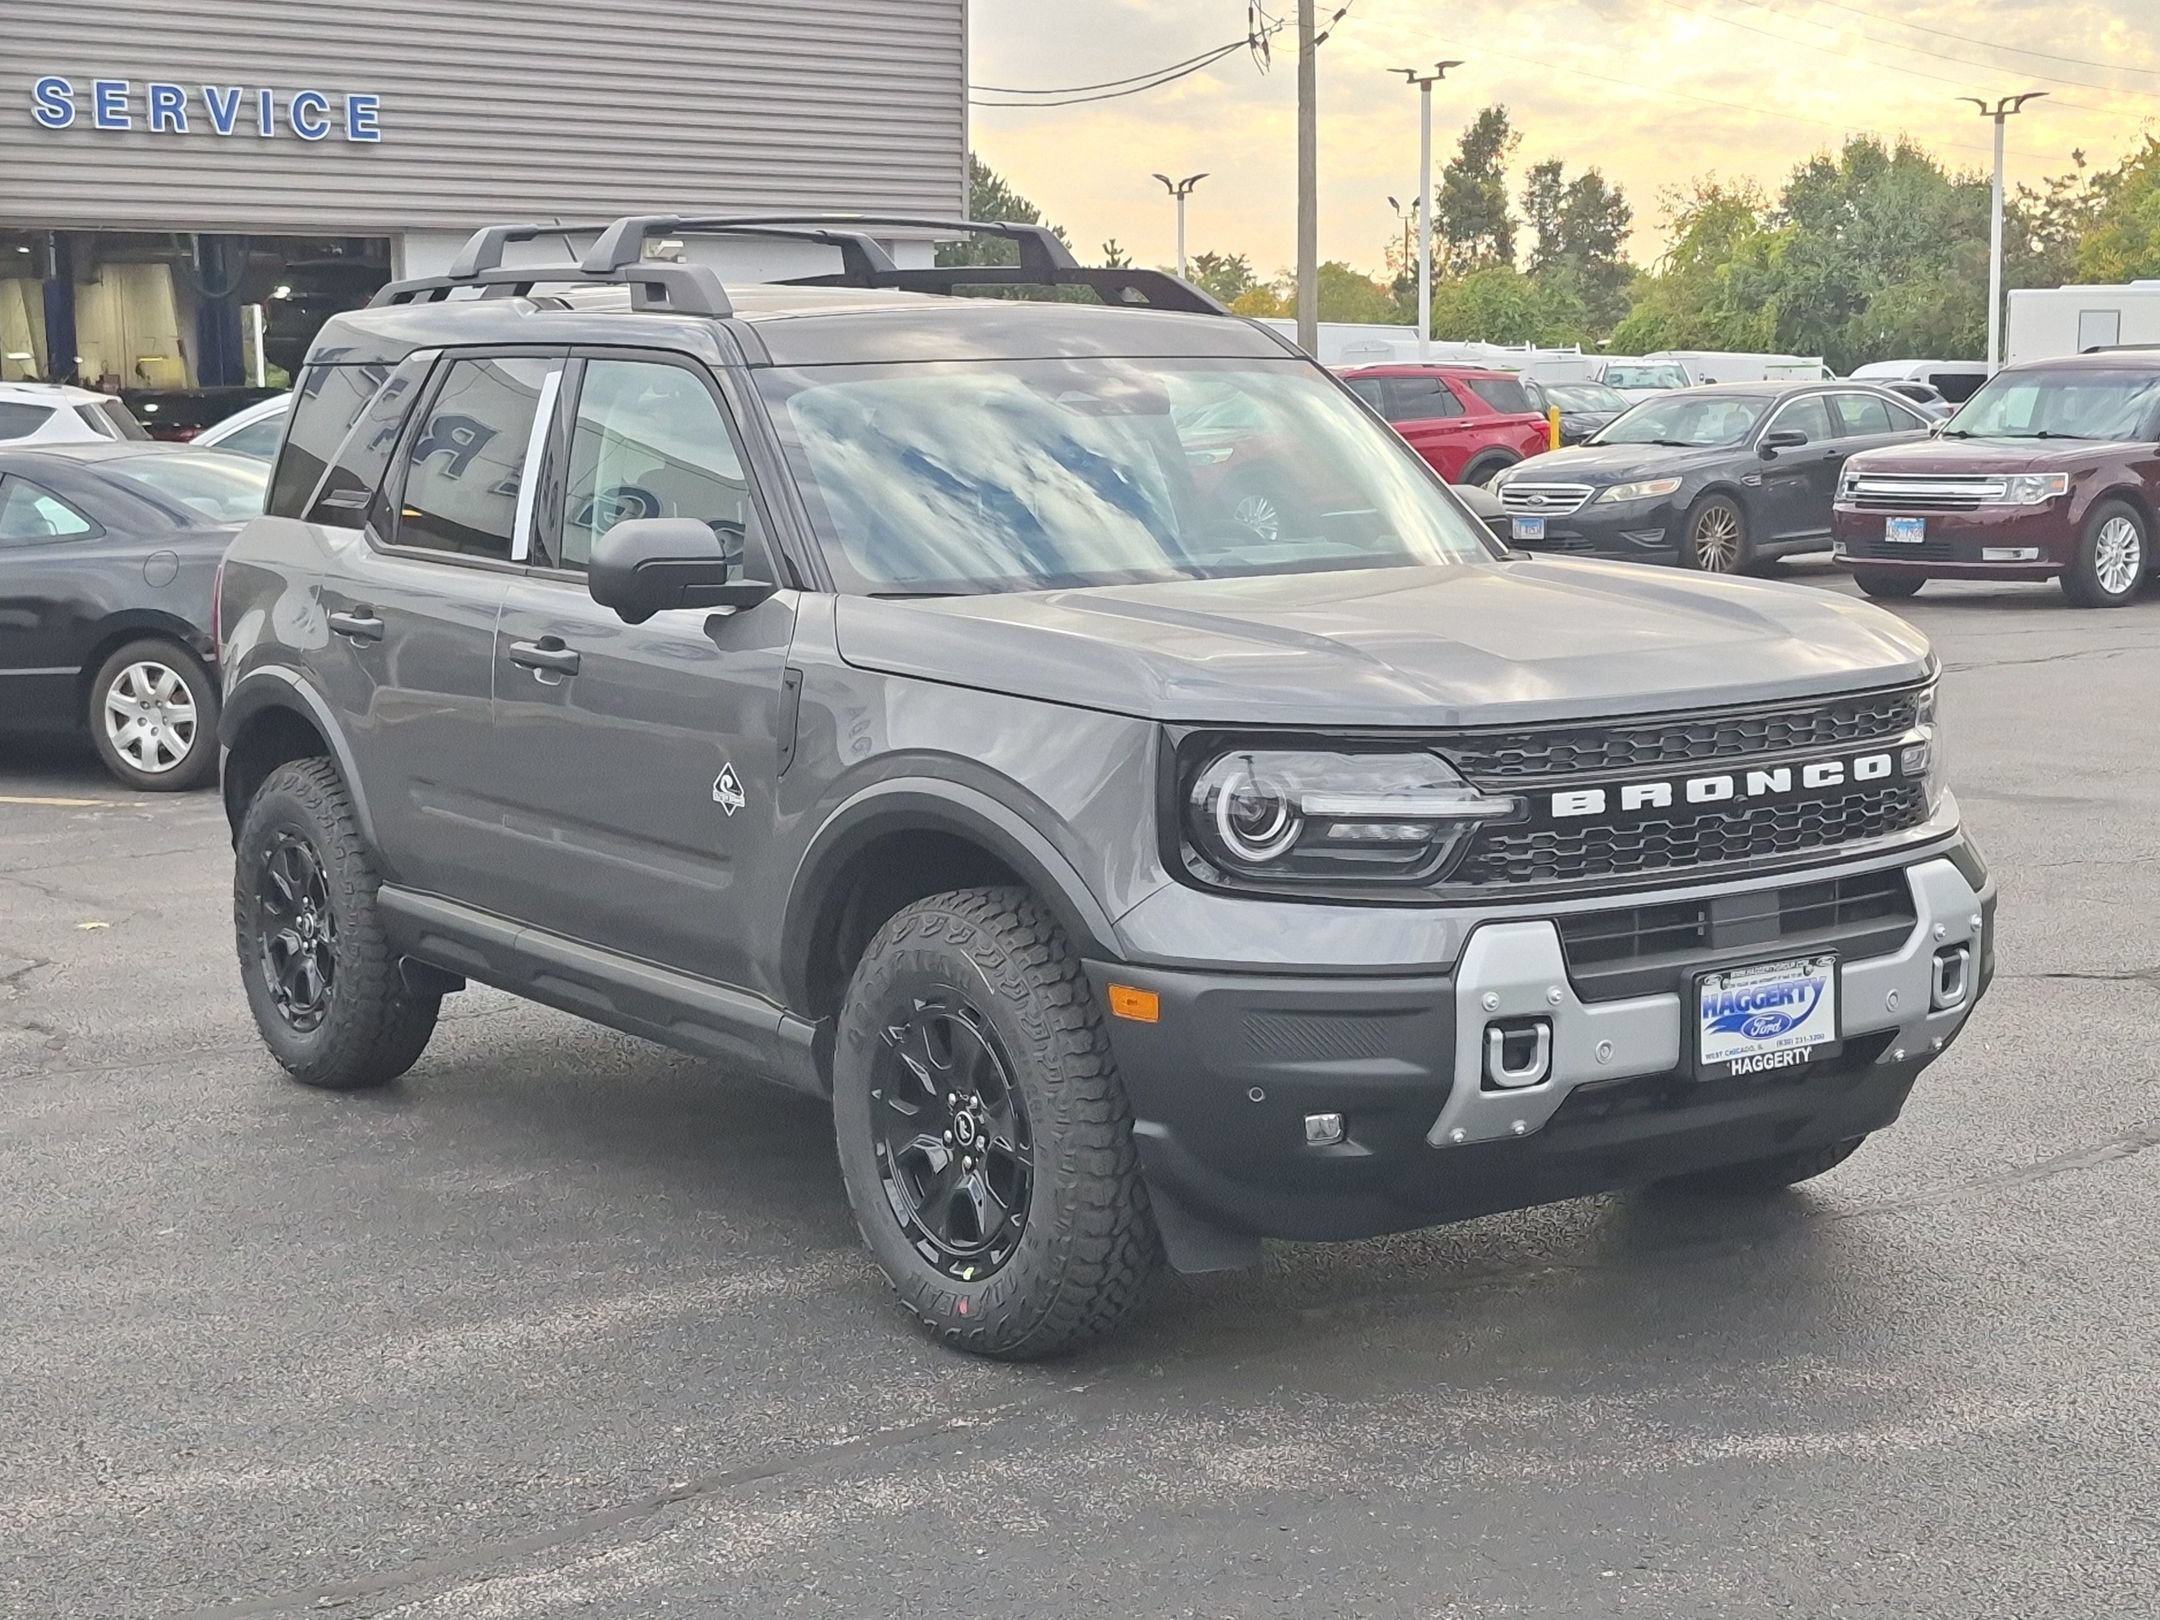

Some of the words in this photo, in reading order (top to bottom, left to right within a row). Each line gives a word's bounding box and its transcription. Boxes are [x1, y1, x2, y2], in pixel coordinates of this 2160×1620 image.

[32, 76, 382, 143] SERVICE
[1551, 753, 1892, 818] BRONCO
[1702, 976, 1827, 1019] HAGGERTY
[1750, 1016, 1782, 1036] Ford
[1731, 1047, 1811, 1076] HAGGERTY
